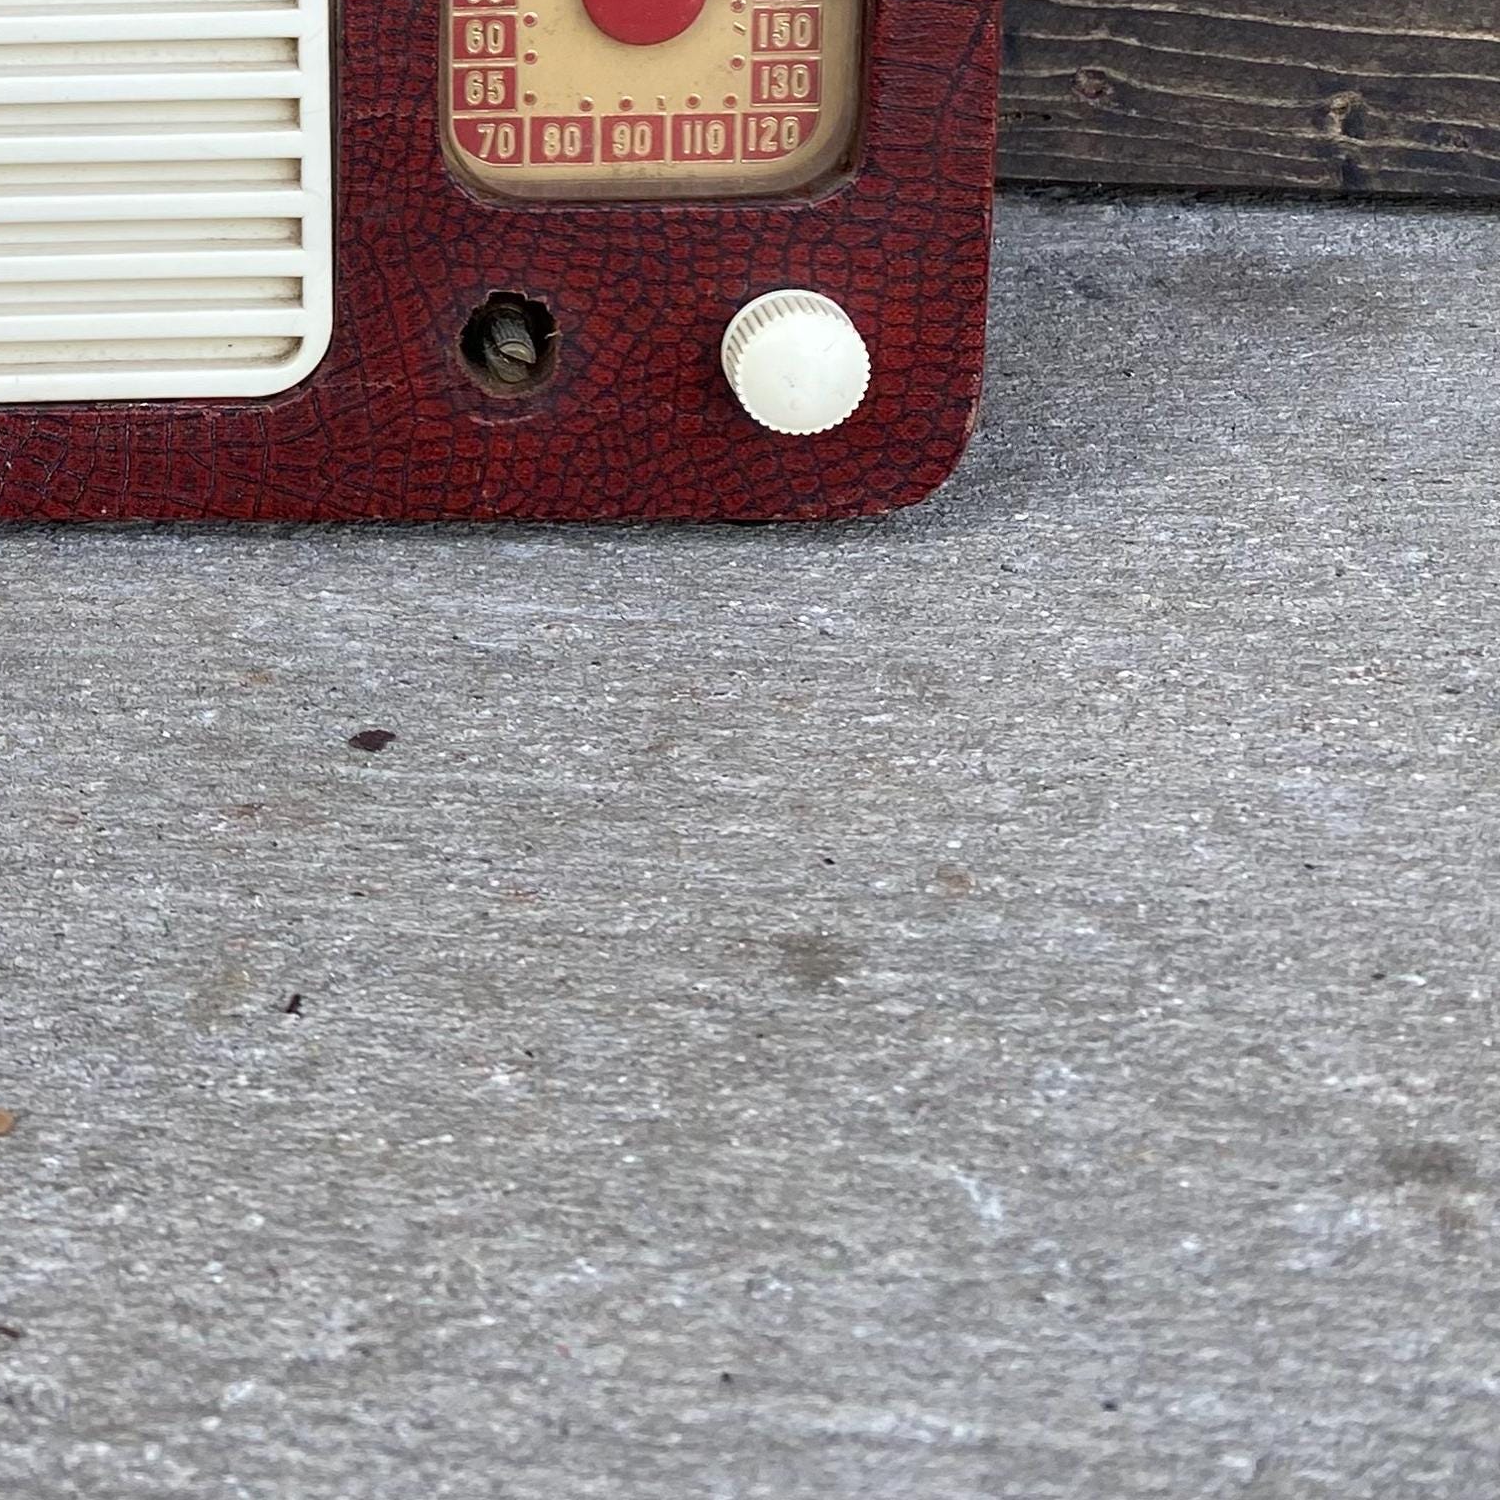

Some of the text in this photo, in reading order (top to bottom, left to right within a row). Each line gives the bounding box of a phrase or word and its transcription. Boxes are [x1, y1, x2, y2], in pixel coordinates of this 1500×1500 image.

[466, 19, 505, 54] 60
[758, 12, 812, 48] 150
[465, 70, 506, 106] 65
[760, 64, 810, 99] 130
[476, 123, 516, 159] 70
[543, 122, 582, 157] 80
[612, 121, 652, 157] 90
[681, 120, 726, 155] 110
[748, 116, 800, 152] 120
